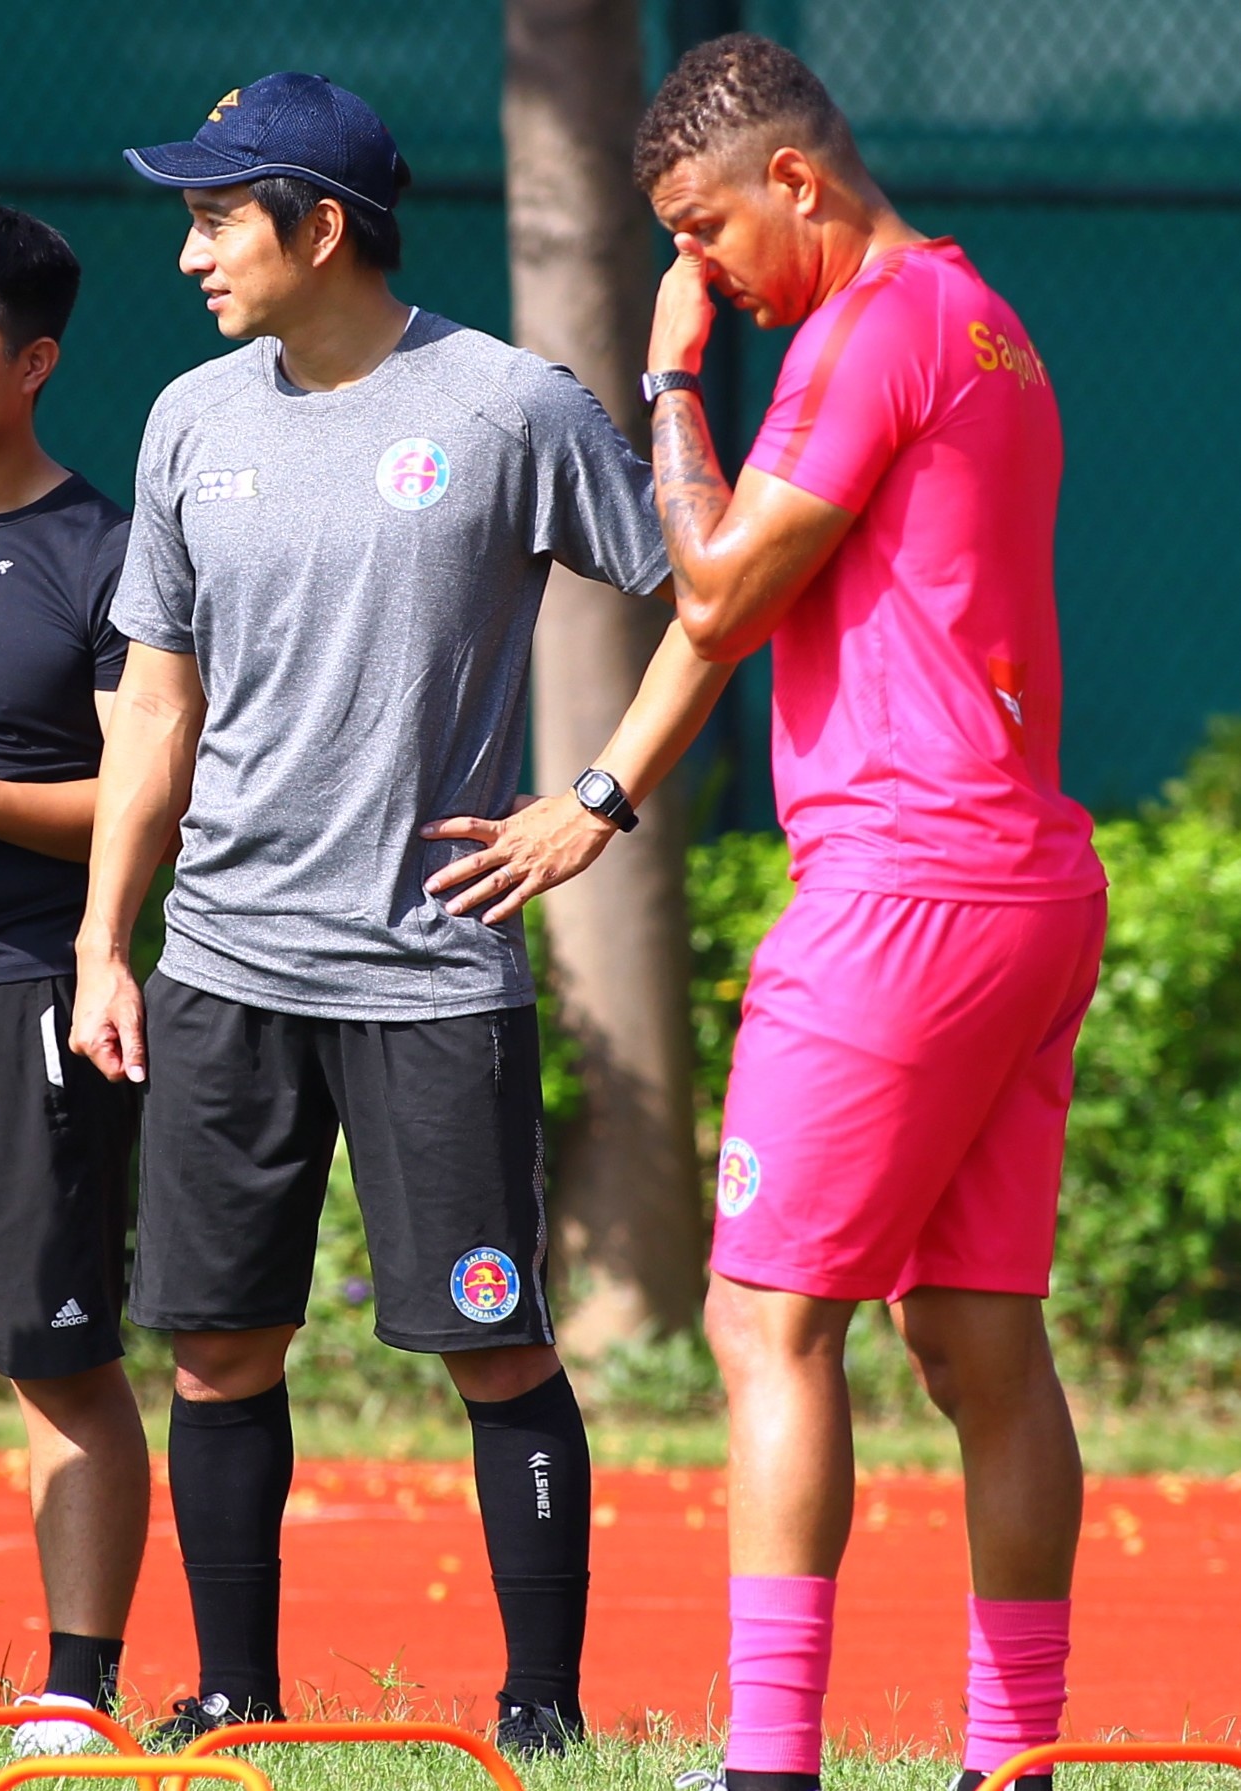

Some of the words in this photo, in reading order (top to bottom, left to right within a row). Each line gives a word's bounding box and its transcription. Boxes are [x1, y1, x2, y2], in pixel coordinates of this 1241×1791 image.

[464, 1253, 479, 1266] SAI
[480, 1252, 501, 1264] GON
[459, 1297, 499, 1319] FOOTBALL
[499, 1293, 515, 1313] CLUB
[51, 1314, 89, 1328] adidas
